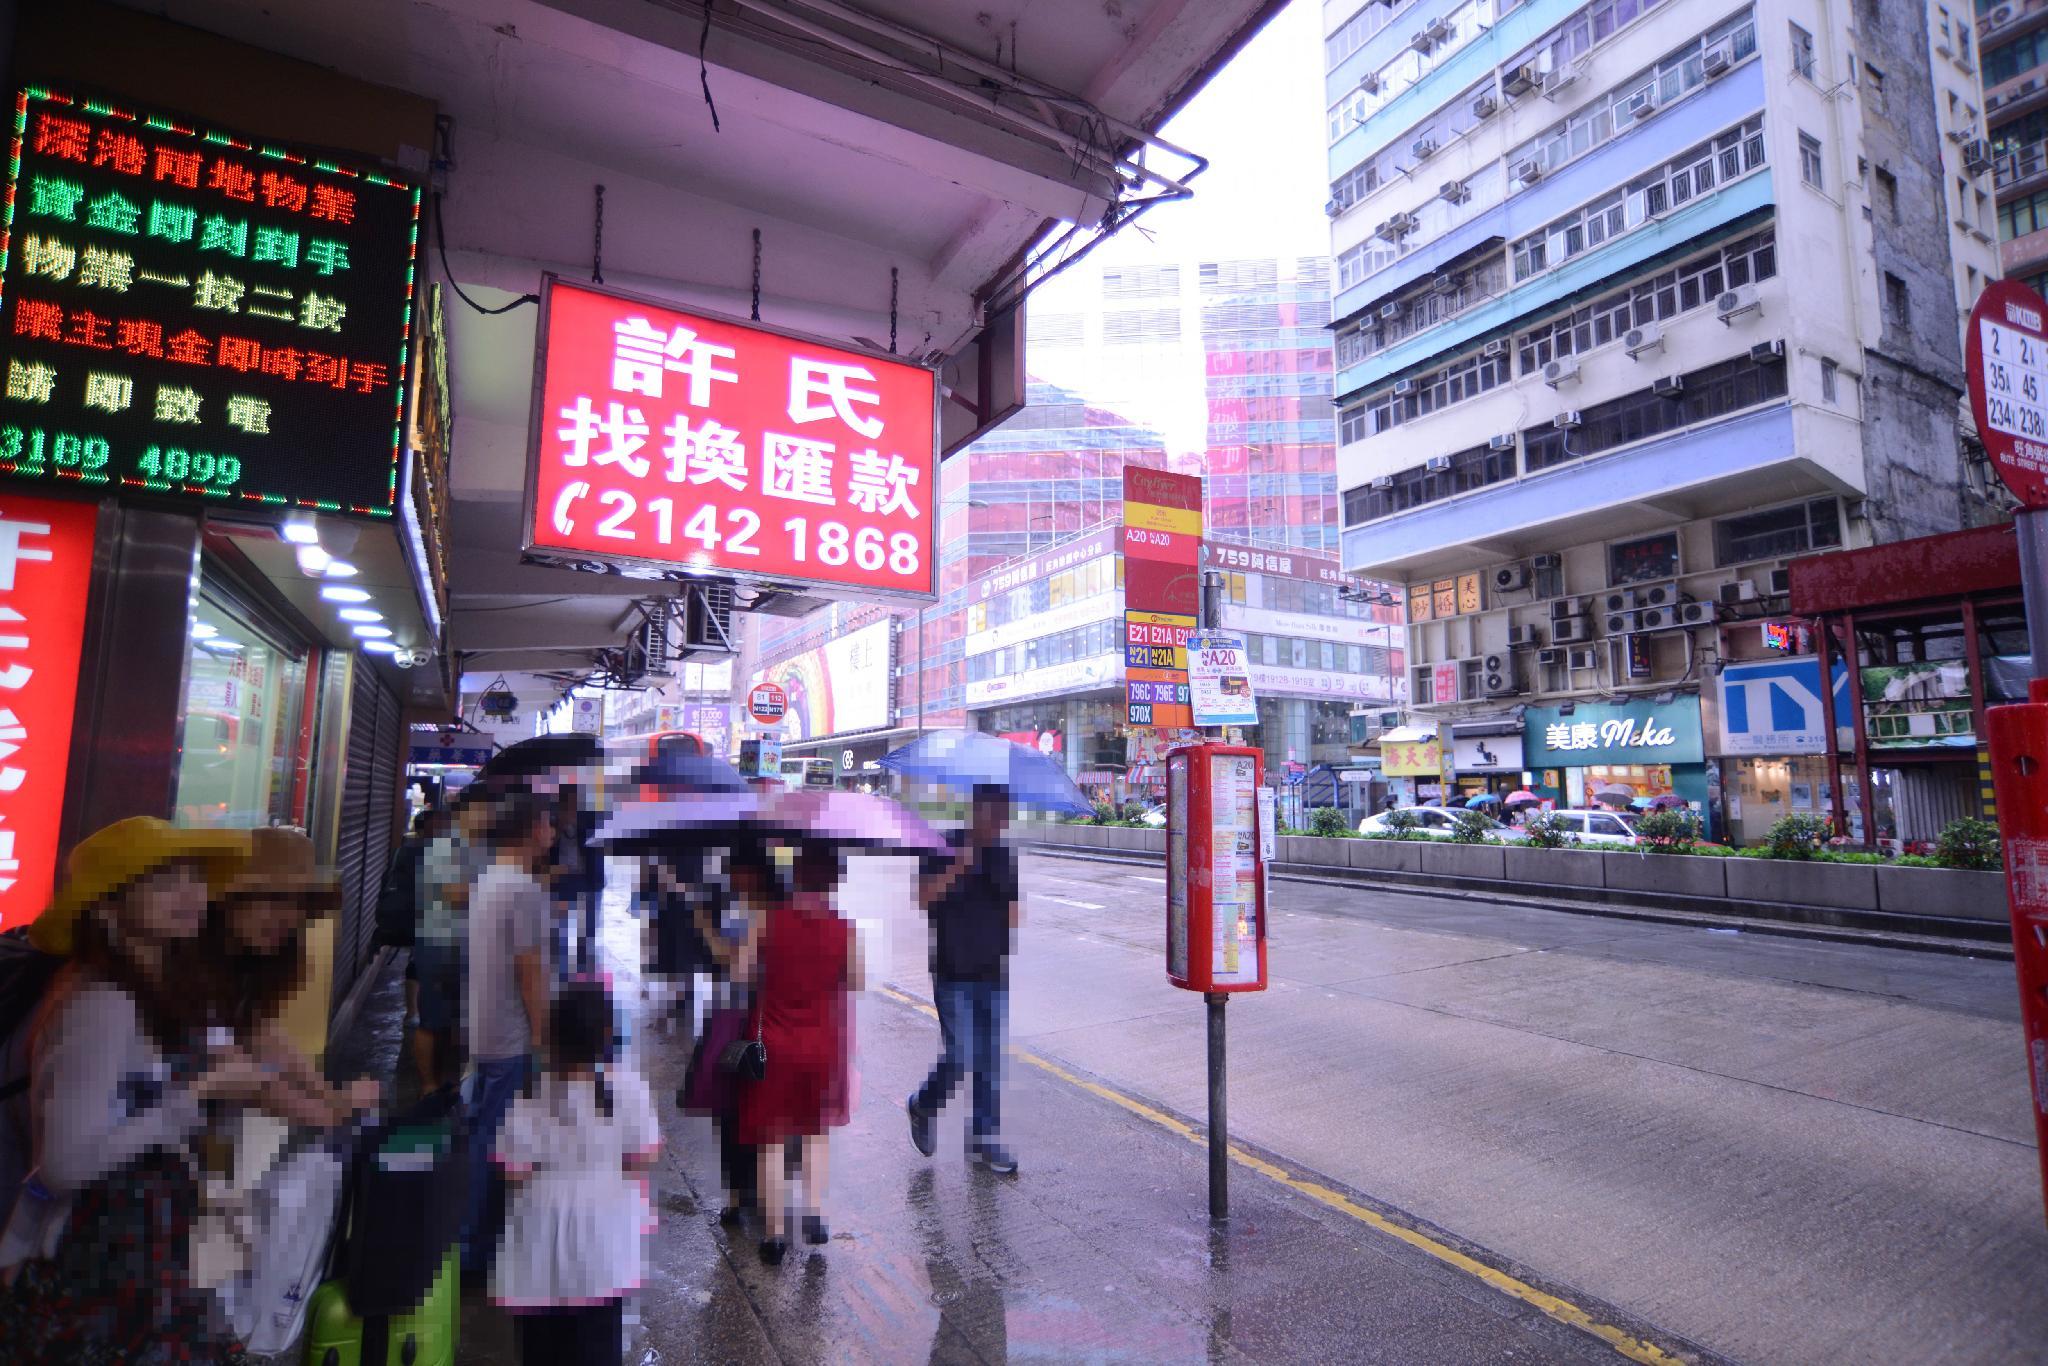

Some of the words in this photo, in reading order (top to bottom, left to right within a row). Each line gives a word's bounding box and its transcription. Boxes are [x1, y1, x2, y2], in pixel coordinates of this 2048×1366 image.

[21, 232, 347, 333] 物業一按二按
[1992, 328, 2000, 355] 2
[2020, 338, 2035, 366] 2A
[613, 317, 885, 439] 許氏
[1990, 362, 2011, 393] 35A
[2023, 374, 2037, 402] 45
[1989, 397, 2016, 430] 234X
[2019, 406, 2047, 440] 238X
[558, 397, 920, 520] 找換匯款
[2014, 440, 2048, 463] 旺角弼
[597, 490, 761, 555] 2142
[784, 518, 919, 575] 1868
[1126, 529, 1146, 543] A20
[1216, 548, 1292, 575] 759阿信屋
[1129, 624, 1148, 643] E21
[1152, 626, 1173, 644] E21A
[1130, 683, 1151, 701] 796C
[1154, 684, 1174, 702] 796E
[1130, 705, 1151, 723] 970X
[1546, 722, 1599, 750] 美康
[1600, 716, 1676, 748] Meka
[1237, 760, 1254, 770] A20
